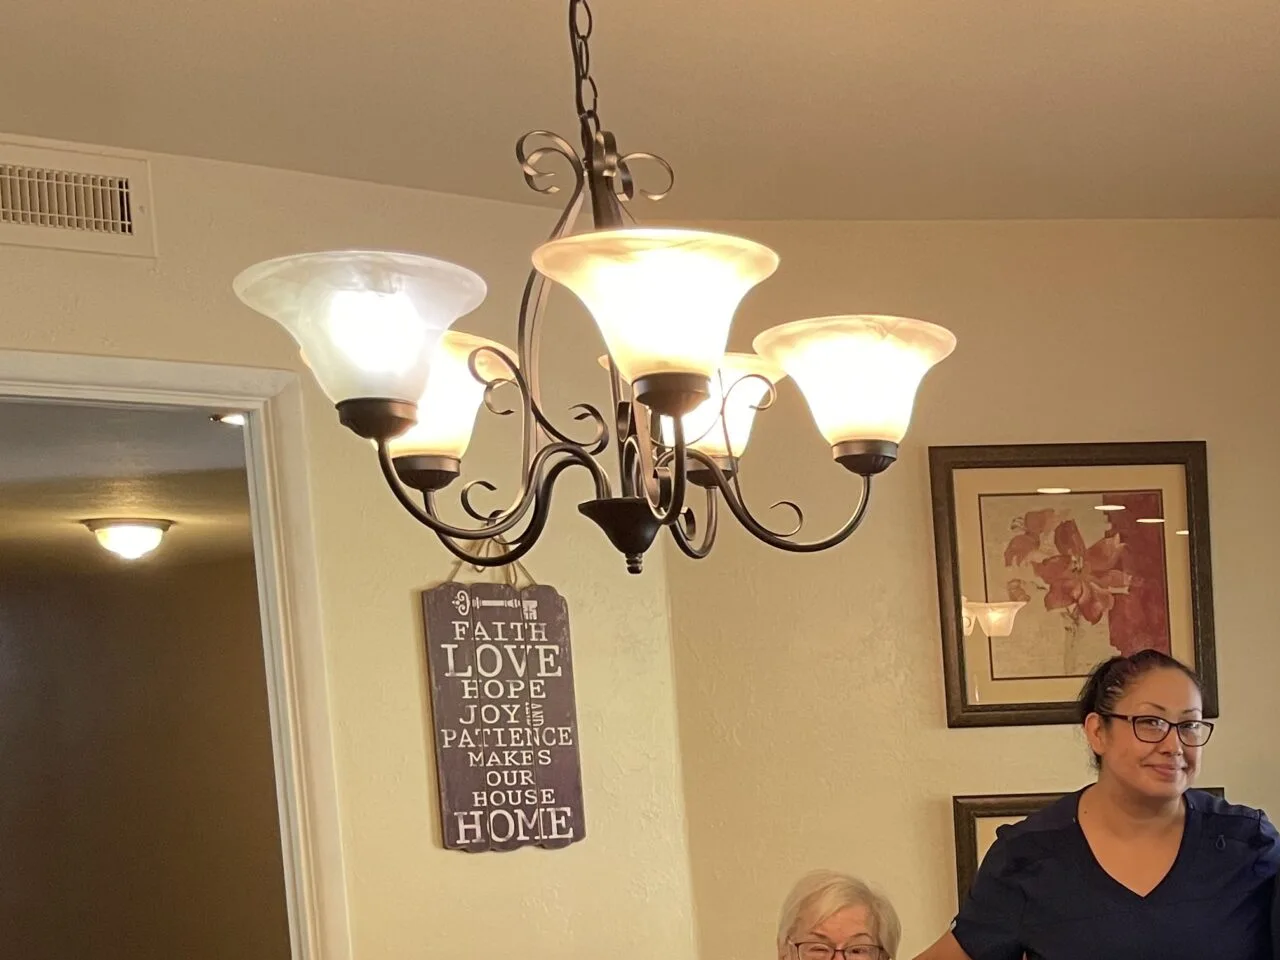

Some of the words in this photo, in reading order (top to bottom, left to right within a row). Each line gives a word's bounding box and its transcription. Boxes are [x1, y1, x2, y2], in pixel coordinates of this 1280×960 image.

[452, 621, 548, 641] FAITH
[441, 643, 562, 677] LOVE
[461, 679, 546, 699] HOPE
[459, 704, 520, 724] JOY
[441, 727, 573, 748] PATIENCE
[468, 750, 552, 767] MAKES
[486, 770, 535, 786] OUR
[472, 789, 556, 807] HOUSE
[454, 807, 574, 844] HOME
